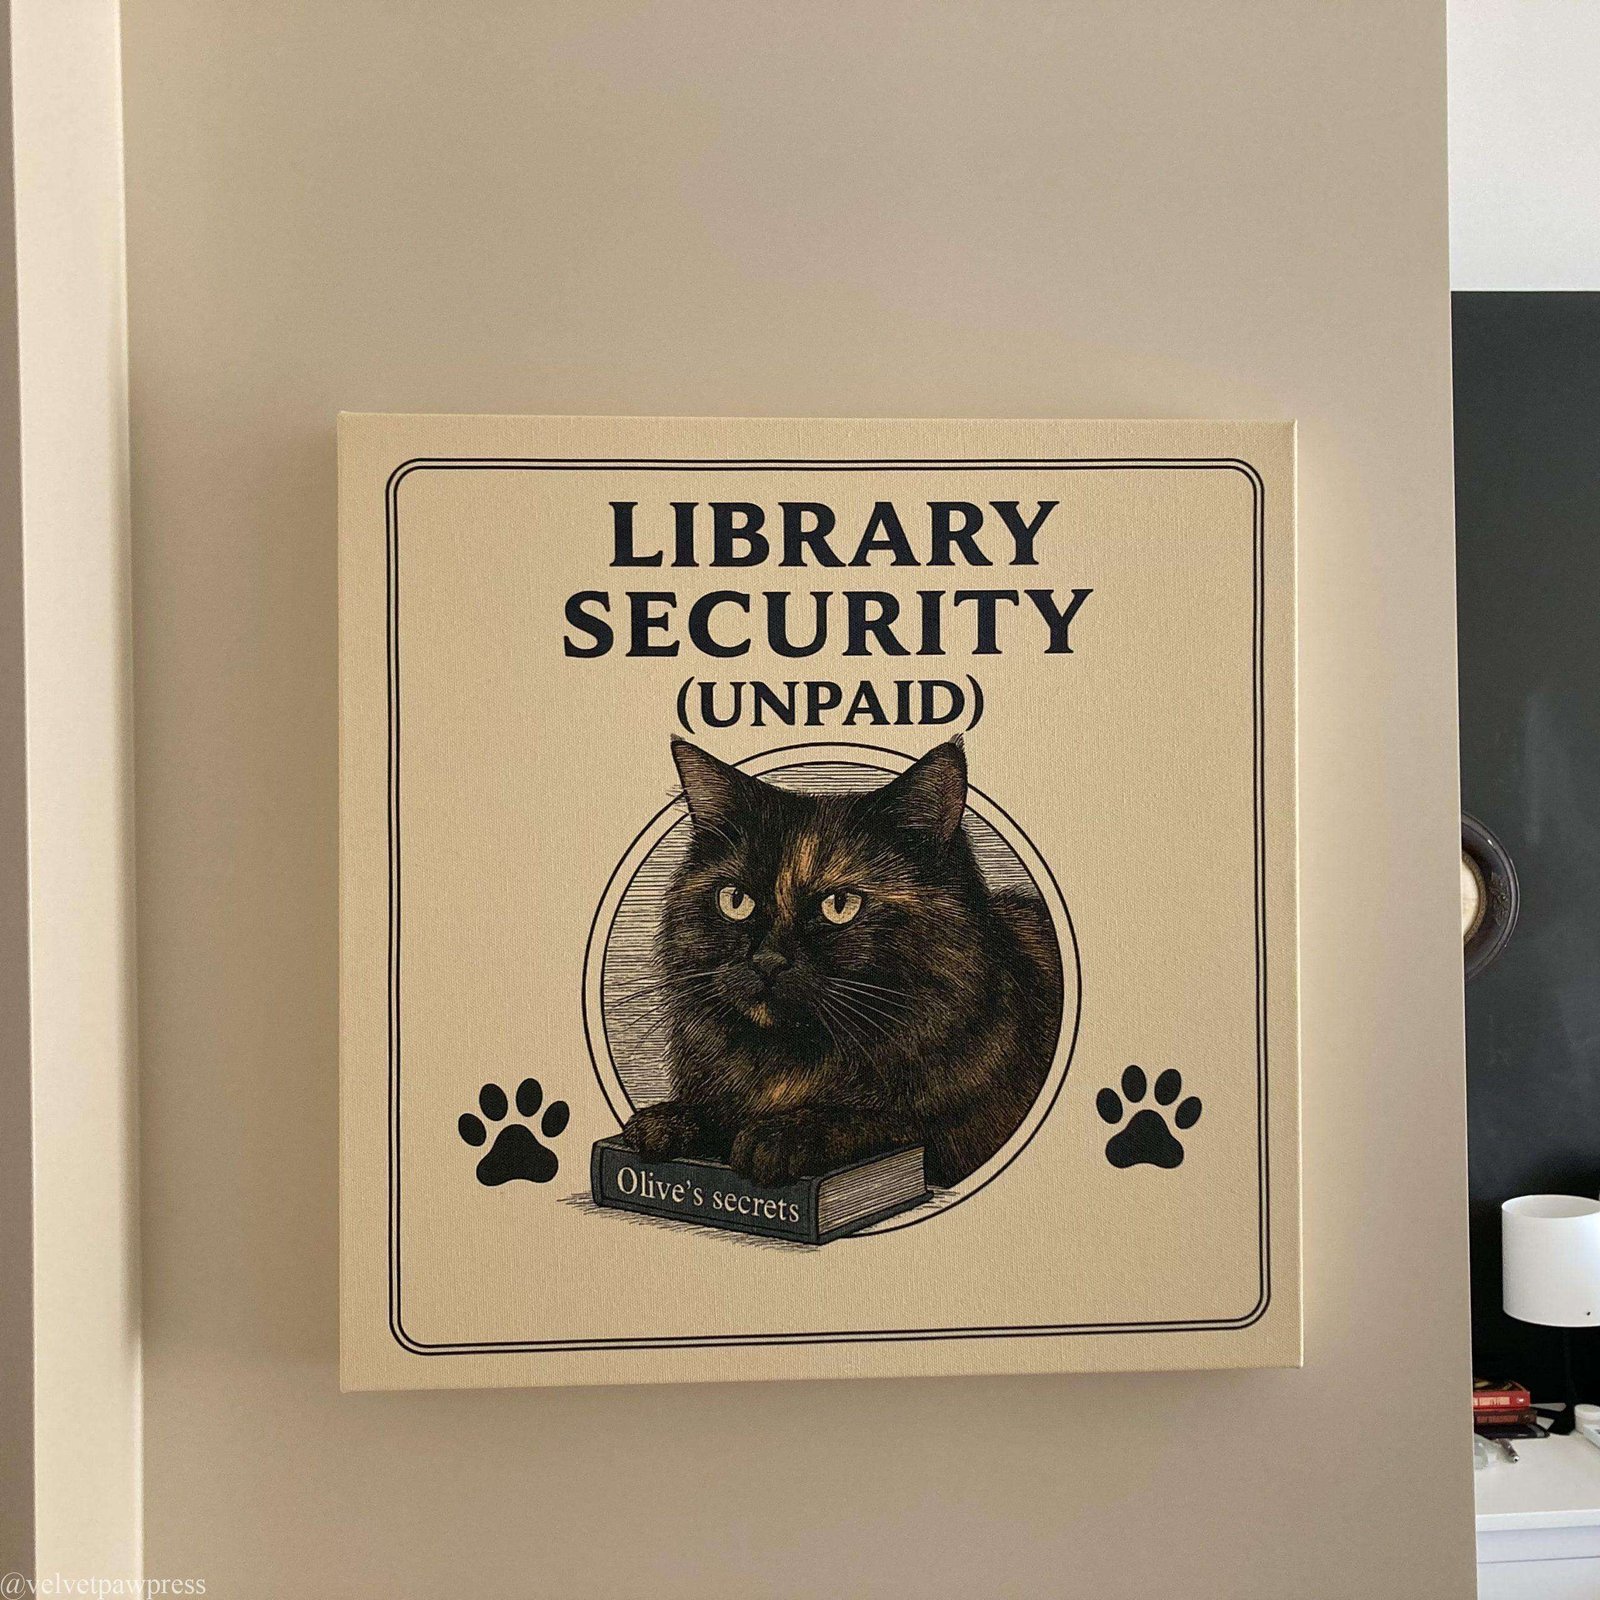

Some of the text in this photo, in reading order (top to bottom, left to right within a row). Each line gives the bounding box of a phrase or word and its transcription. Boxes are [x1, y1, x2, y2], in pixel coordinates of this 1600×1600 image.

[608, 500, 1060, 568] LIBRARY
[563, 588, 1094, 658] SECURITY
[676, 674, 985, 734] (UNPAID)
[616, 1166, 800, 1223] Olive’s secrets
